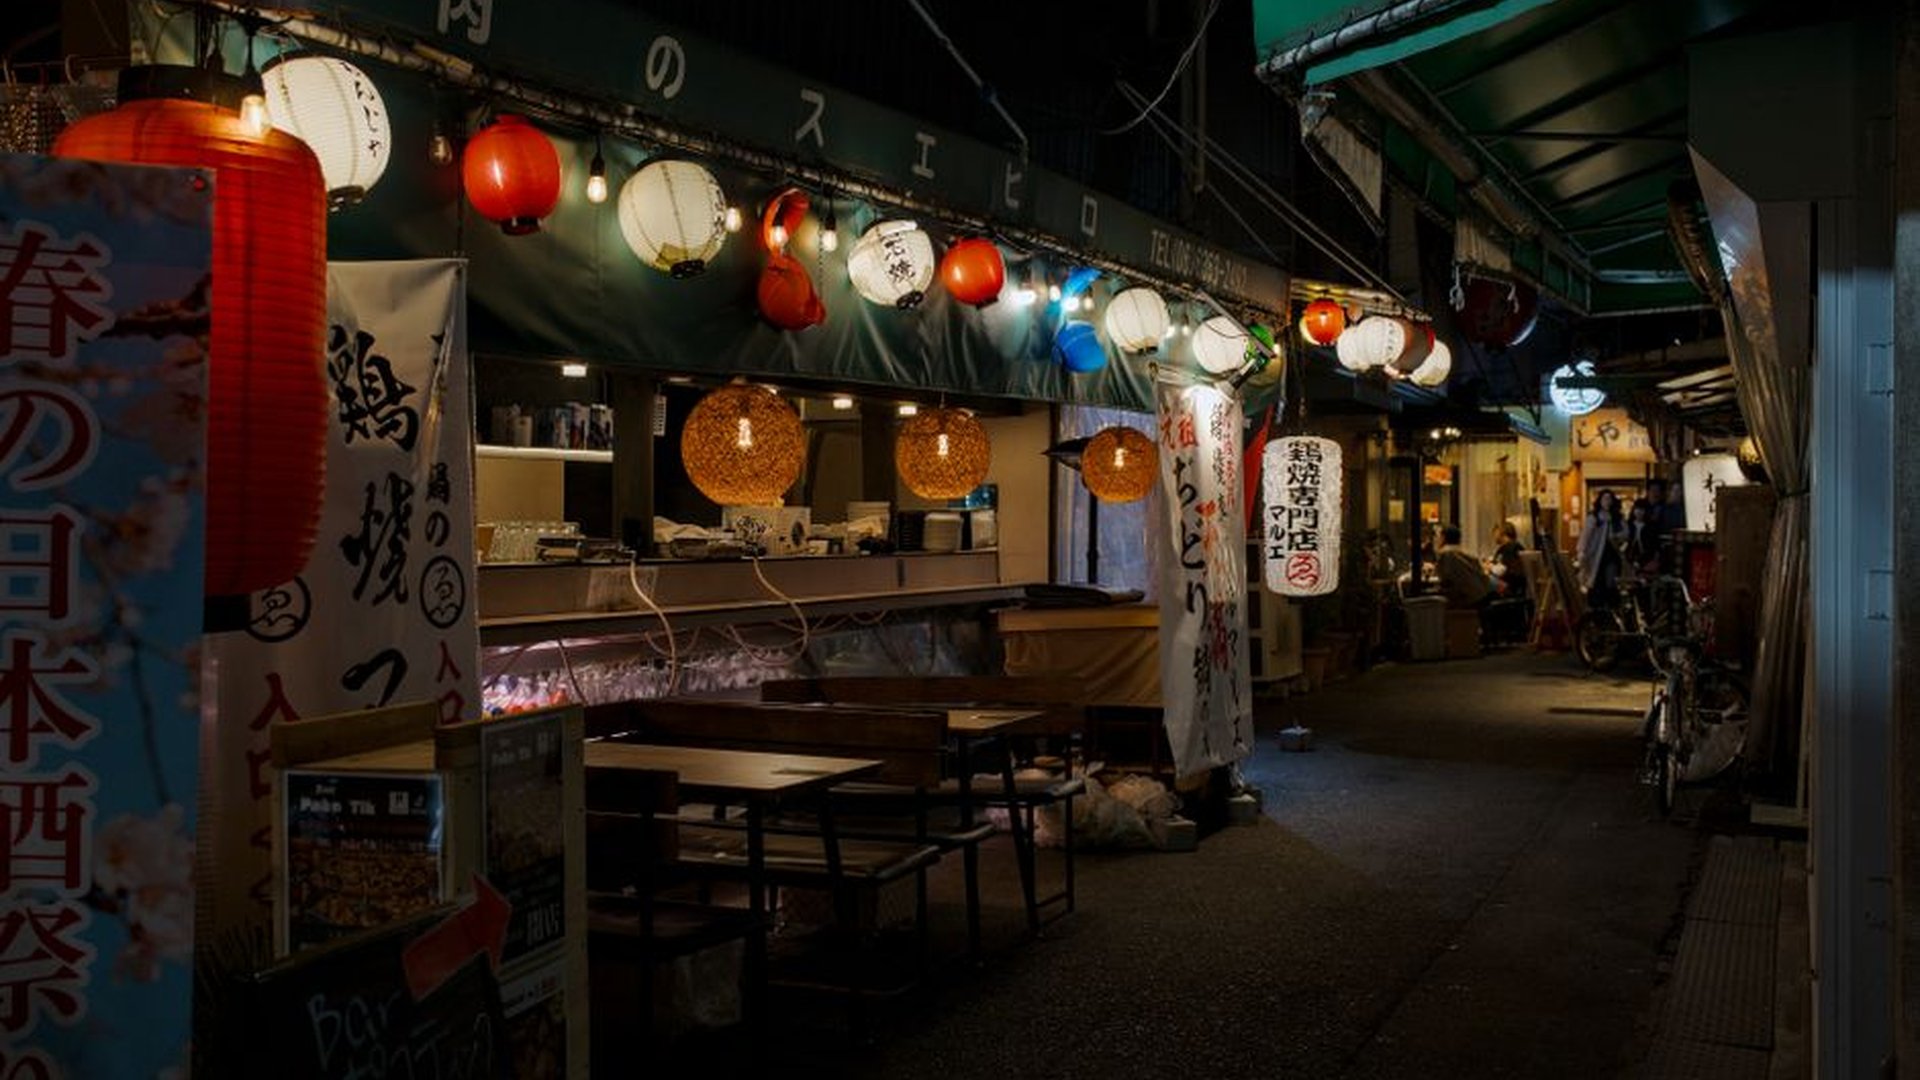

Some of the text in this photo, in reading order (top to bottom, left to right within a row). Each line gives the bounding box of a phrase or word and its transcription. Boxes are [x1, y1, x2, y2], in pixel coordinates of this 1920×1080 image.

[0, 225, 103, 1080] 春の日本酒祭
[1269, 504, 1286, 560] マルエ
